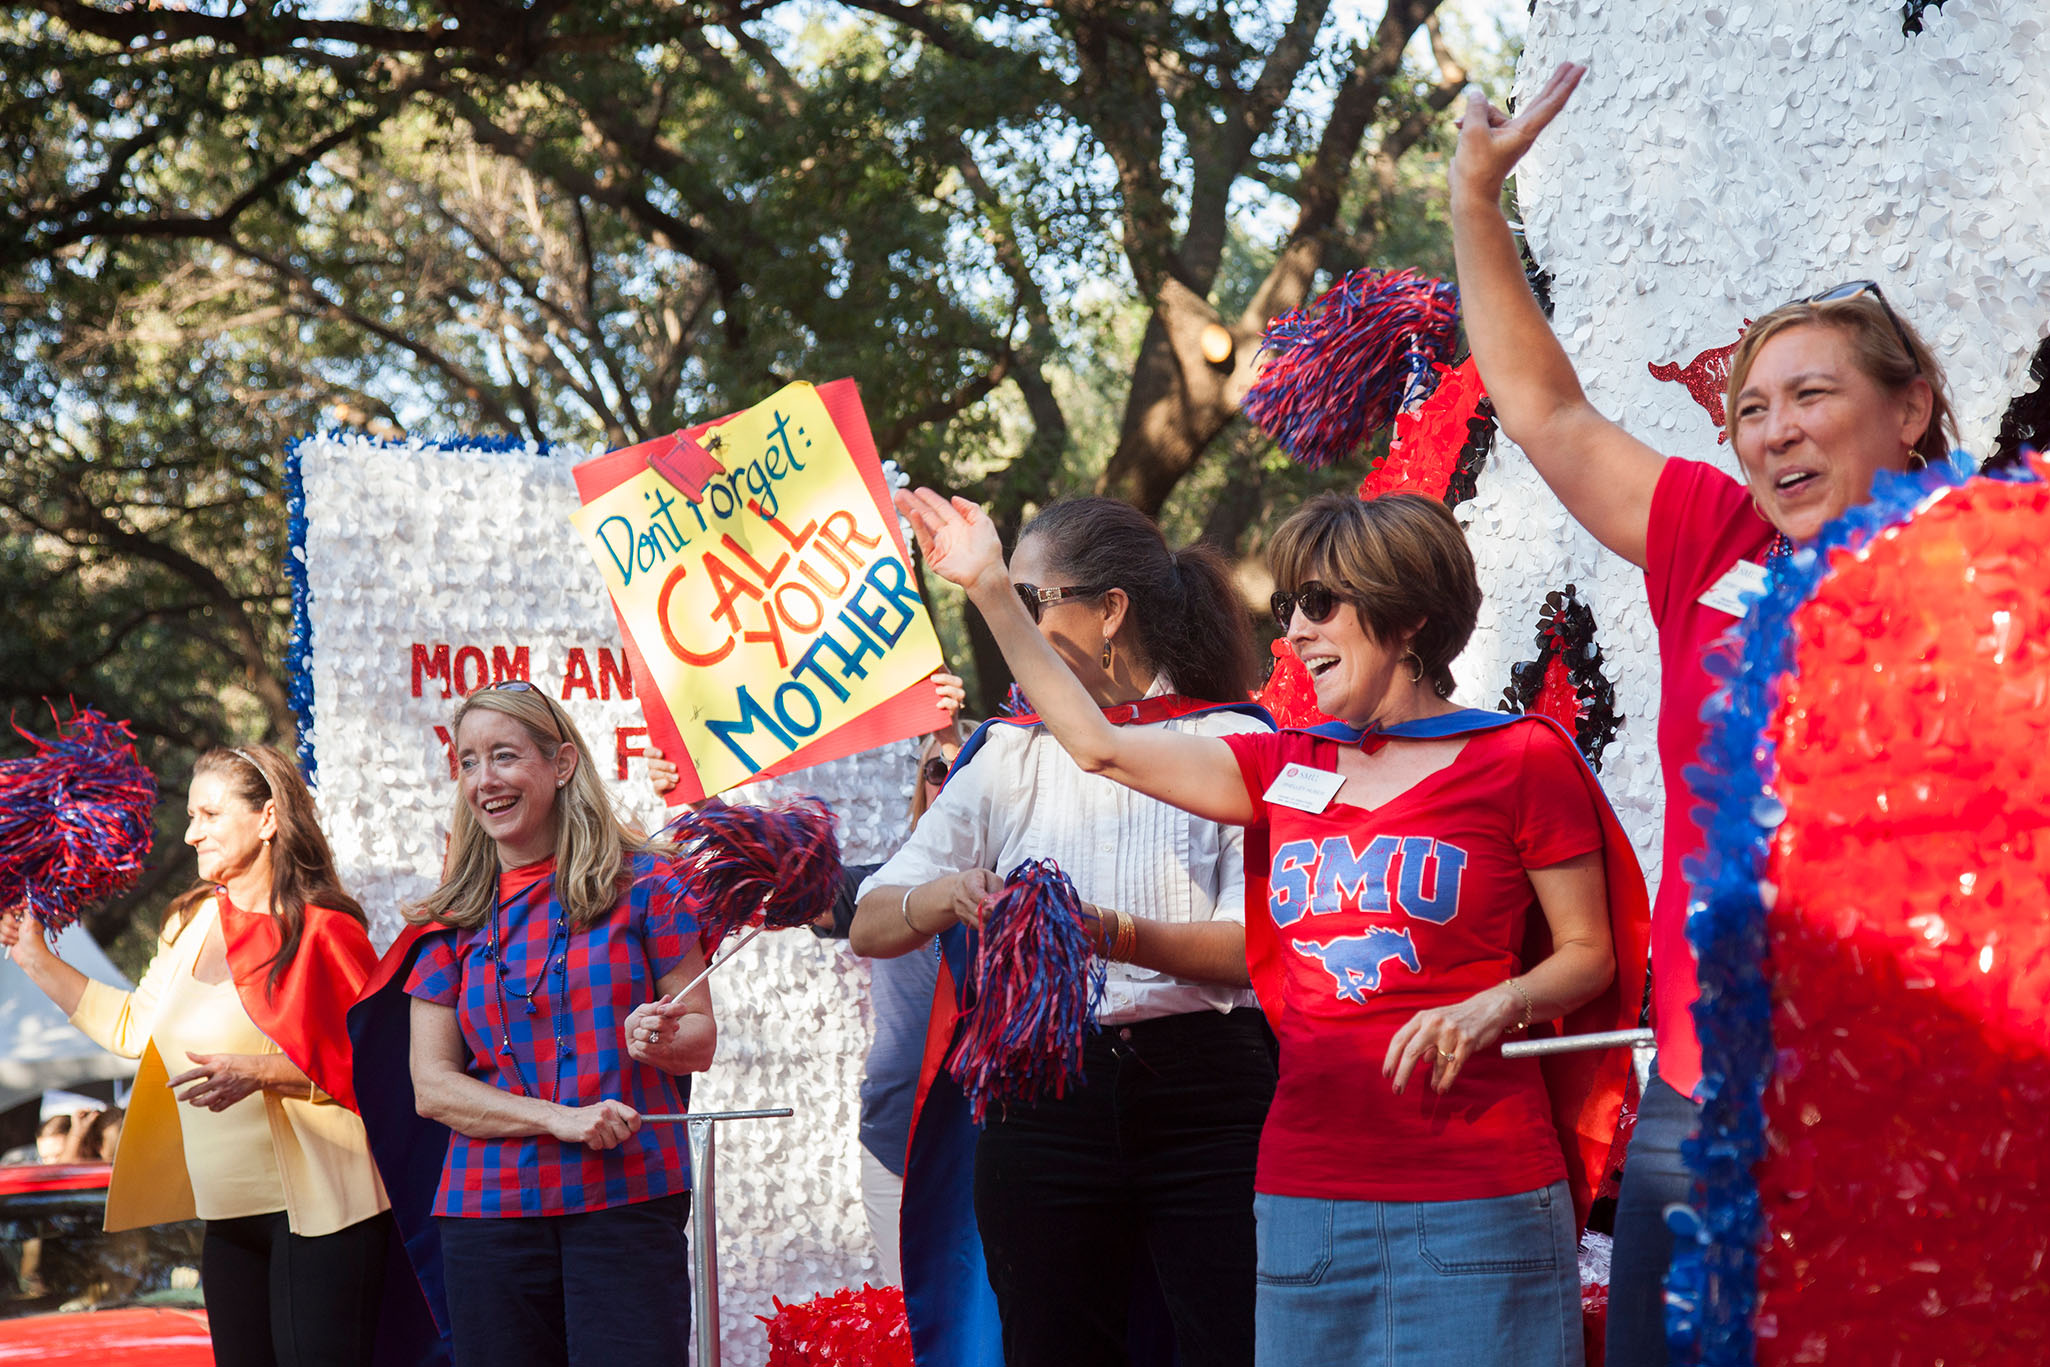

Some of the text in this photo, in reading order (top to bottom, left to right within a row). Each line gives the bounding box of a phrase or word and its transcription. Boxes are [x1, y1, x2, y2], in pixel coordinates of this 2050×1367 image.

[1705, 354, 1735, 384] SM
[657, 498, 818, 667] CALL
[744, 510, 882, 669] YOUR
[411, 643, 639, 701] MOM AN
[705, 556, 924, 774] MOTHER
[1269, 834, 1468, 929] SMU
